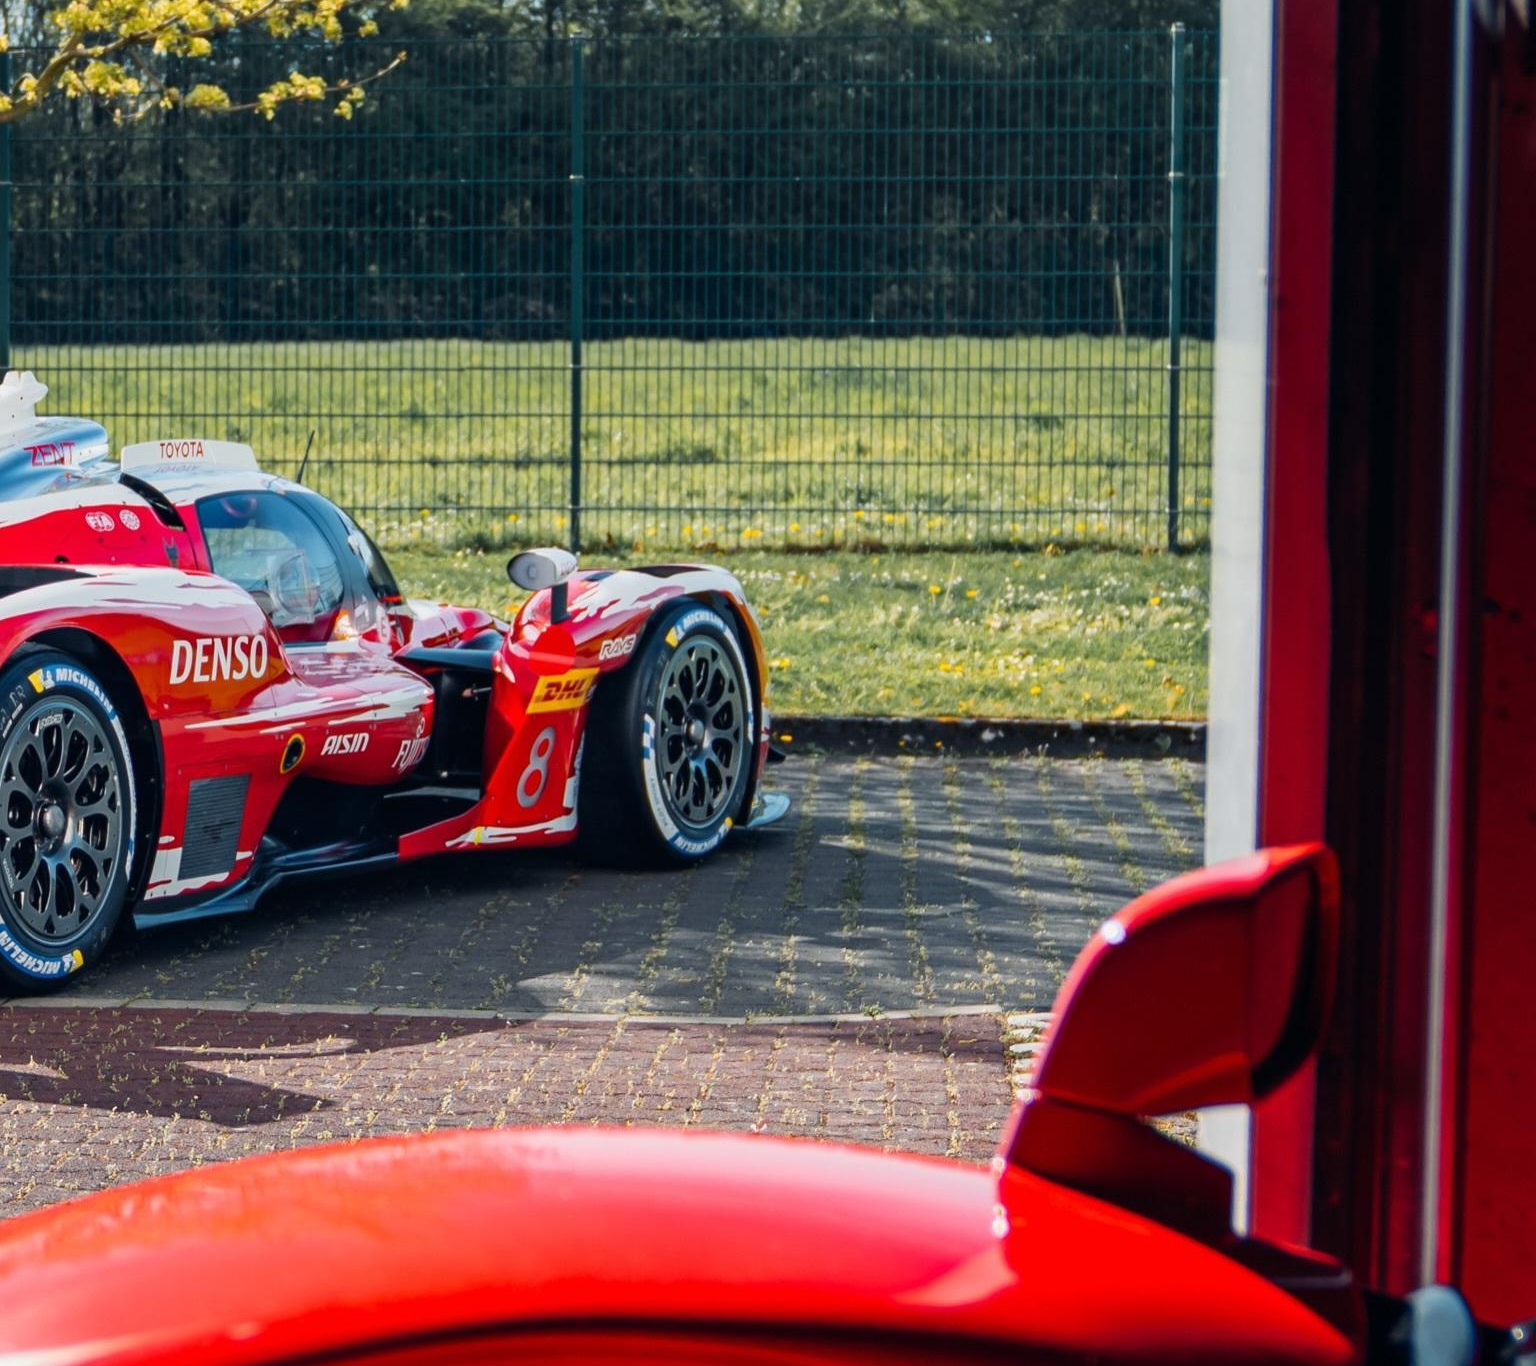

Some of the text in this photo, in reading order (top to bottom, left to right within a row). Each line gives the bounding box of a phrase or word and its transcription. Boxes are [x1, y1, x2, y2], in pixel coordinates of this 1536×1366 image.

[23, 442, 76, 467] ZENT
[159, 441, 204, 459] TOYOTA
[169, 635, 268, 685] DENSO
[598, 633, 636, 661] RAYS
[56, 667, 113, 714] MICHELIN
[540, 678, 586, 703] DHL
[321, 733, 369, 756] AISIN
[516, 726, 556, 808] 8
